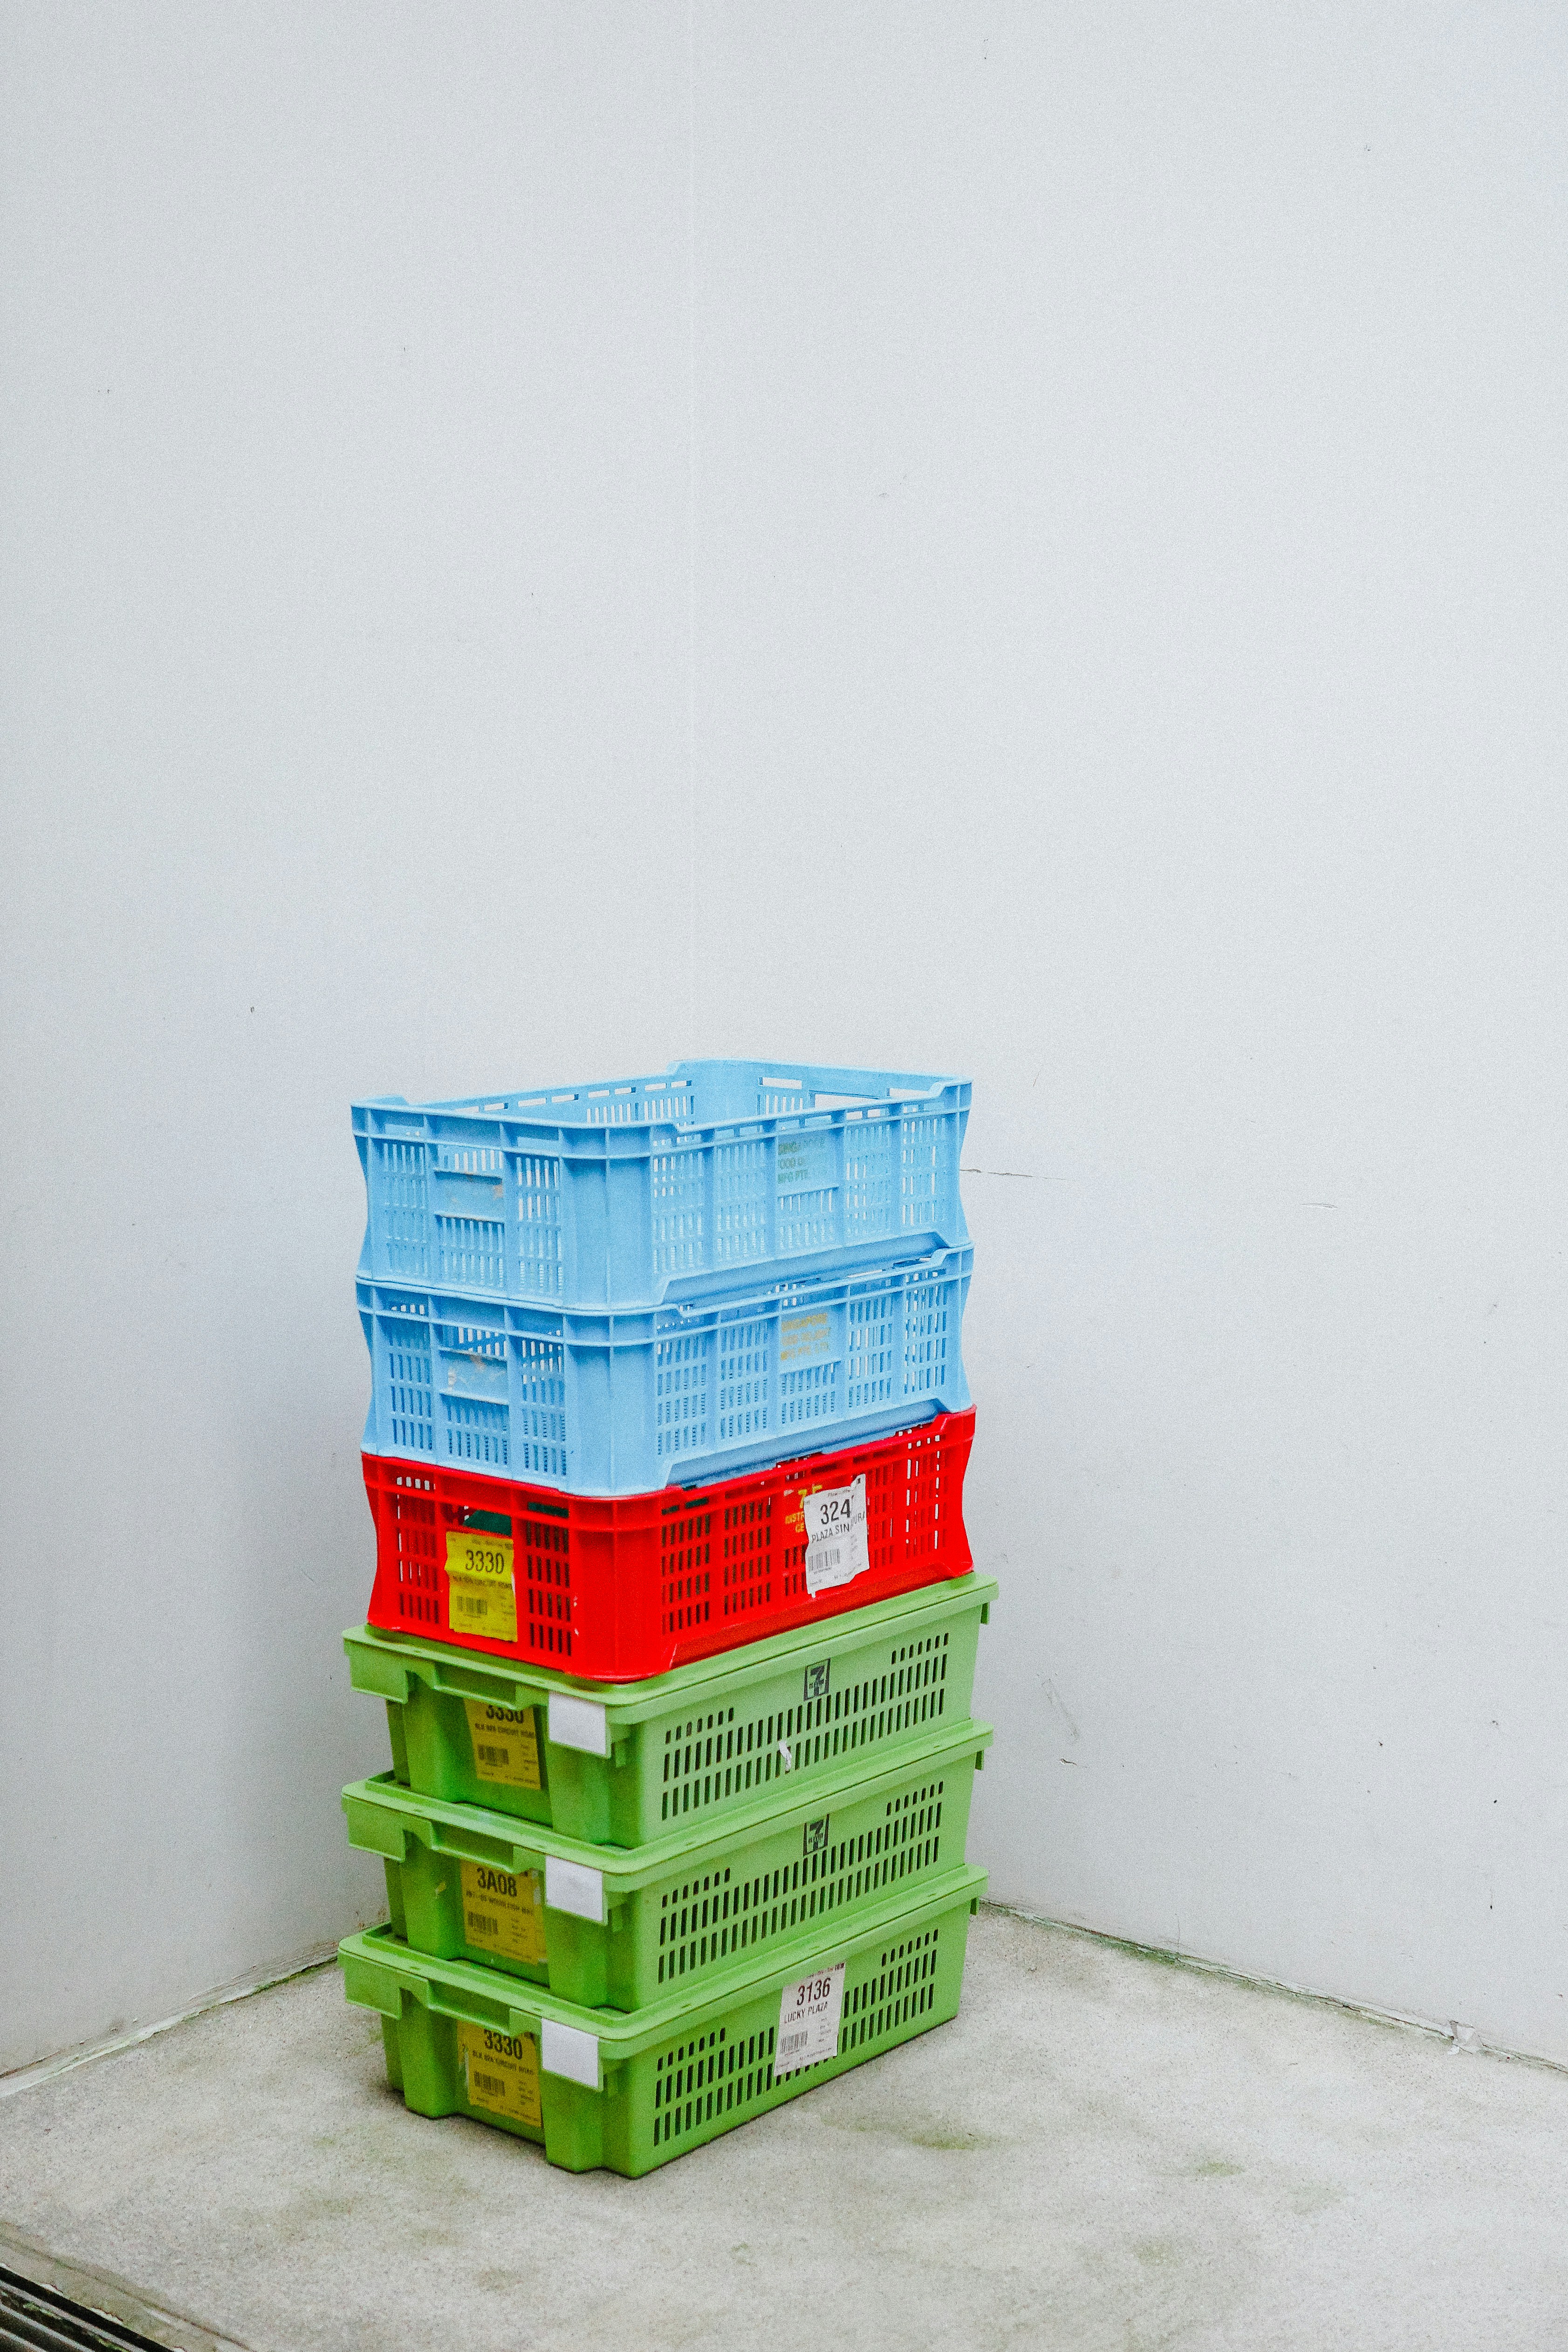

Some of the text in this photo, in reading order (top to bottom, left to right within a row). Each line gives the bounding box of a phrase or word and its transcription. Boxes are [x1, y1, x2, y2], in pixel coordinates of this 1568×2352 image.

[820, 1495, 854, 1525] 324
[812, 1528, 833, 1543] PLAZA
[466, 1550, 505, 1574] 3330
[476, 1867, 518, 1897] 3A08
[796, 1977, 831, 2006] 3136
[784, 2002, 828, 2024] LUCKY PLAZA
[483, 2029, 523, 2060] 3330
